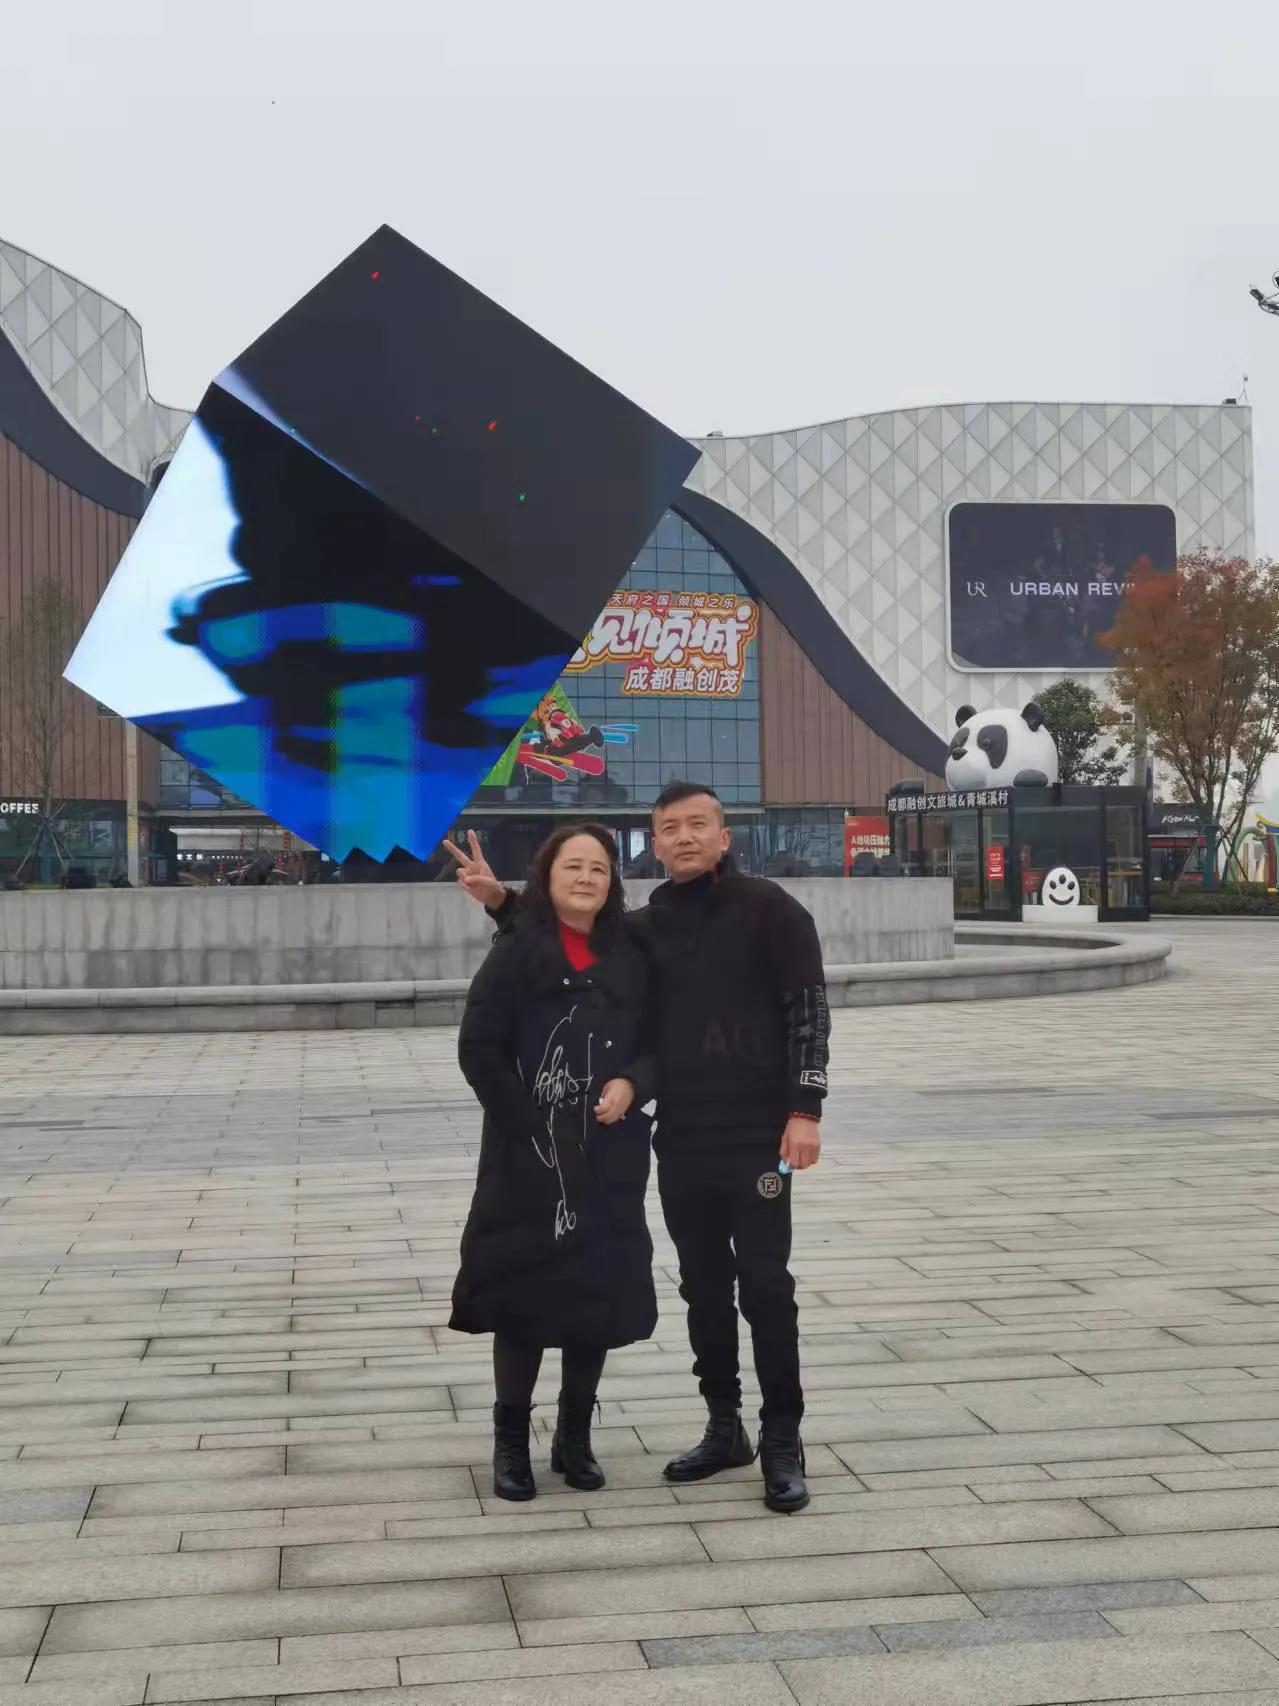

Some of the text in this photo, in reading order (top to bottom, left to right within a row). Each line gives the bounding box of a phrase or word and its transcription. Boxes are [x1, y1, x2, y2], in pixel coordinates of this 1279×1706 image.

[611, 593, 670, 607] 天府之国
[1010, 582, 1078, 596] URBAN
[571, 604, 752, 666] 见倾城
[625, 667, 740, 692] 成都融创茂
[887, 790, 1008, 812] 成都融创文旅城&青城溪村
